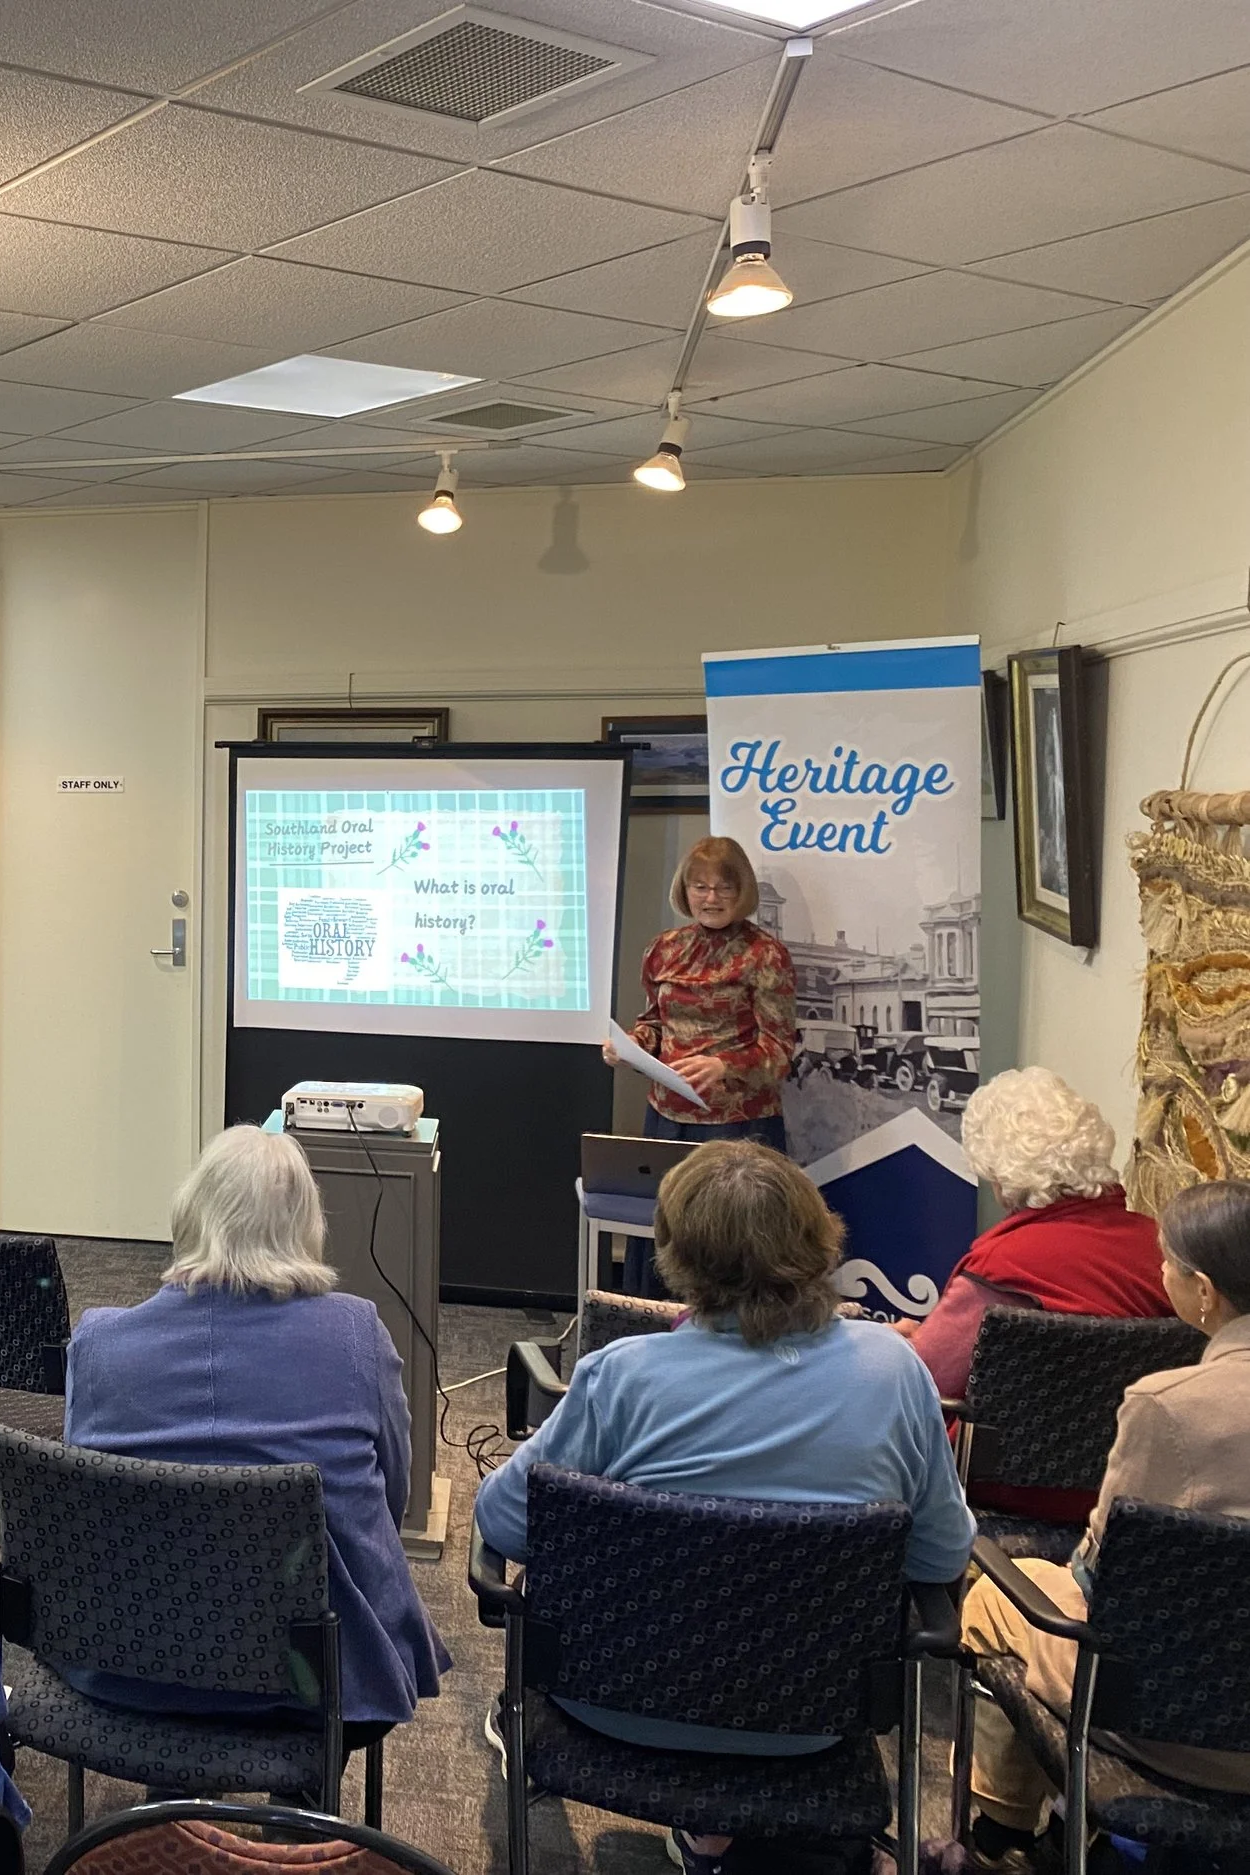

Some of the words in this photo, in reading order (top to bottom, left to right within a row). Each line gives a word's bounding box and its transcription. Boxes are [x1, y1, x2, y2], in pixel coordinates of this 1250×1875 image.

[719, 739, 955, 816] Heritage
[265, 820, 337, 836] Southland
[341, 818, 374, 833] Oral
[760, 797, 891, 854] Event
[268, 842, 316, 860] History
[320, 841, 372, 859] Project
[414, 880, 459, 895] What
[464, 881, 475, 895] is
[481, 879, 515, 895] oral
[313, 923, 350, 938] ORAL
[415, 912, 475, 935] history?
[309, 939, 375, 956] HISTORY
